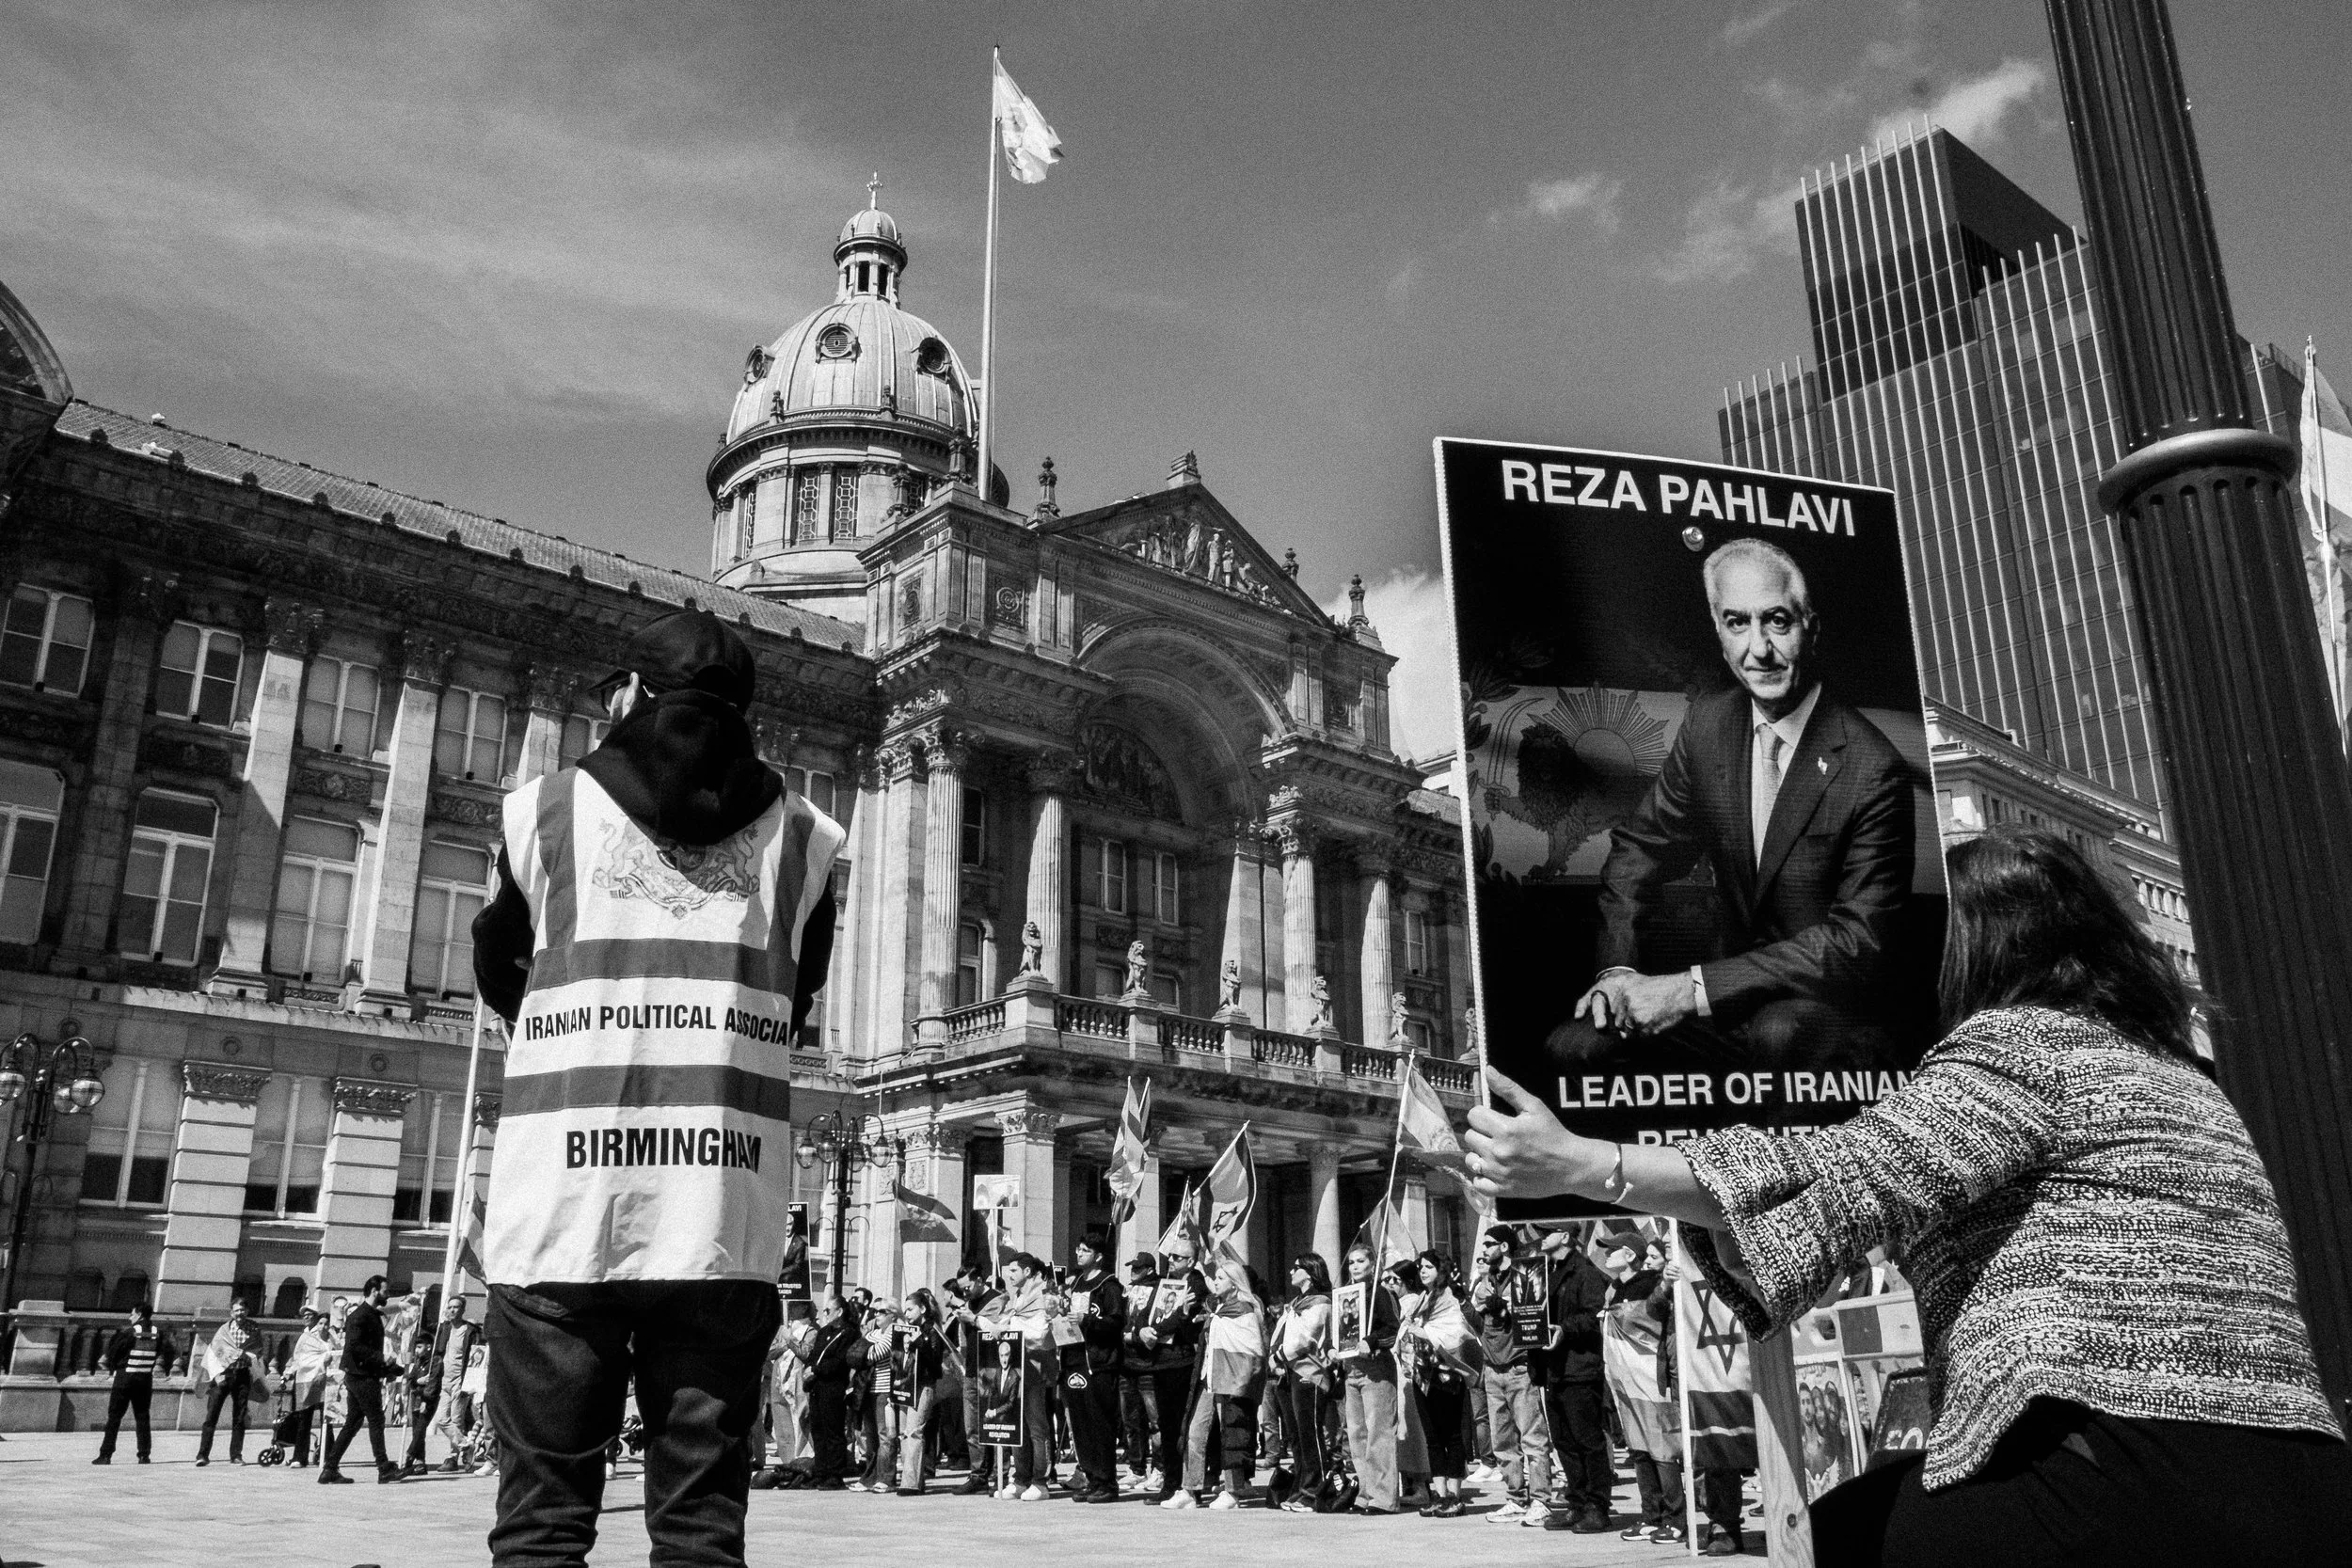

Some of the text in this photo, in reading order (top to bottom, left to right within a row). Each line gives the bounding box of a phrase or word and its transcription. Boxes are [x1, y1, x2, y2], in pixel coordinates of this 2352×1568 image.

[1502, 459, 1855, 536] REZA PAHLAVI
[525, 1005, 789, 1046] IRANIAN POLITICAL ASSOCIA
[1558, 1073, 1714, 1108] LEADER
[1724, 1071, 1773, 1104] OF
